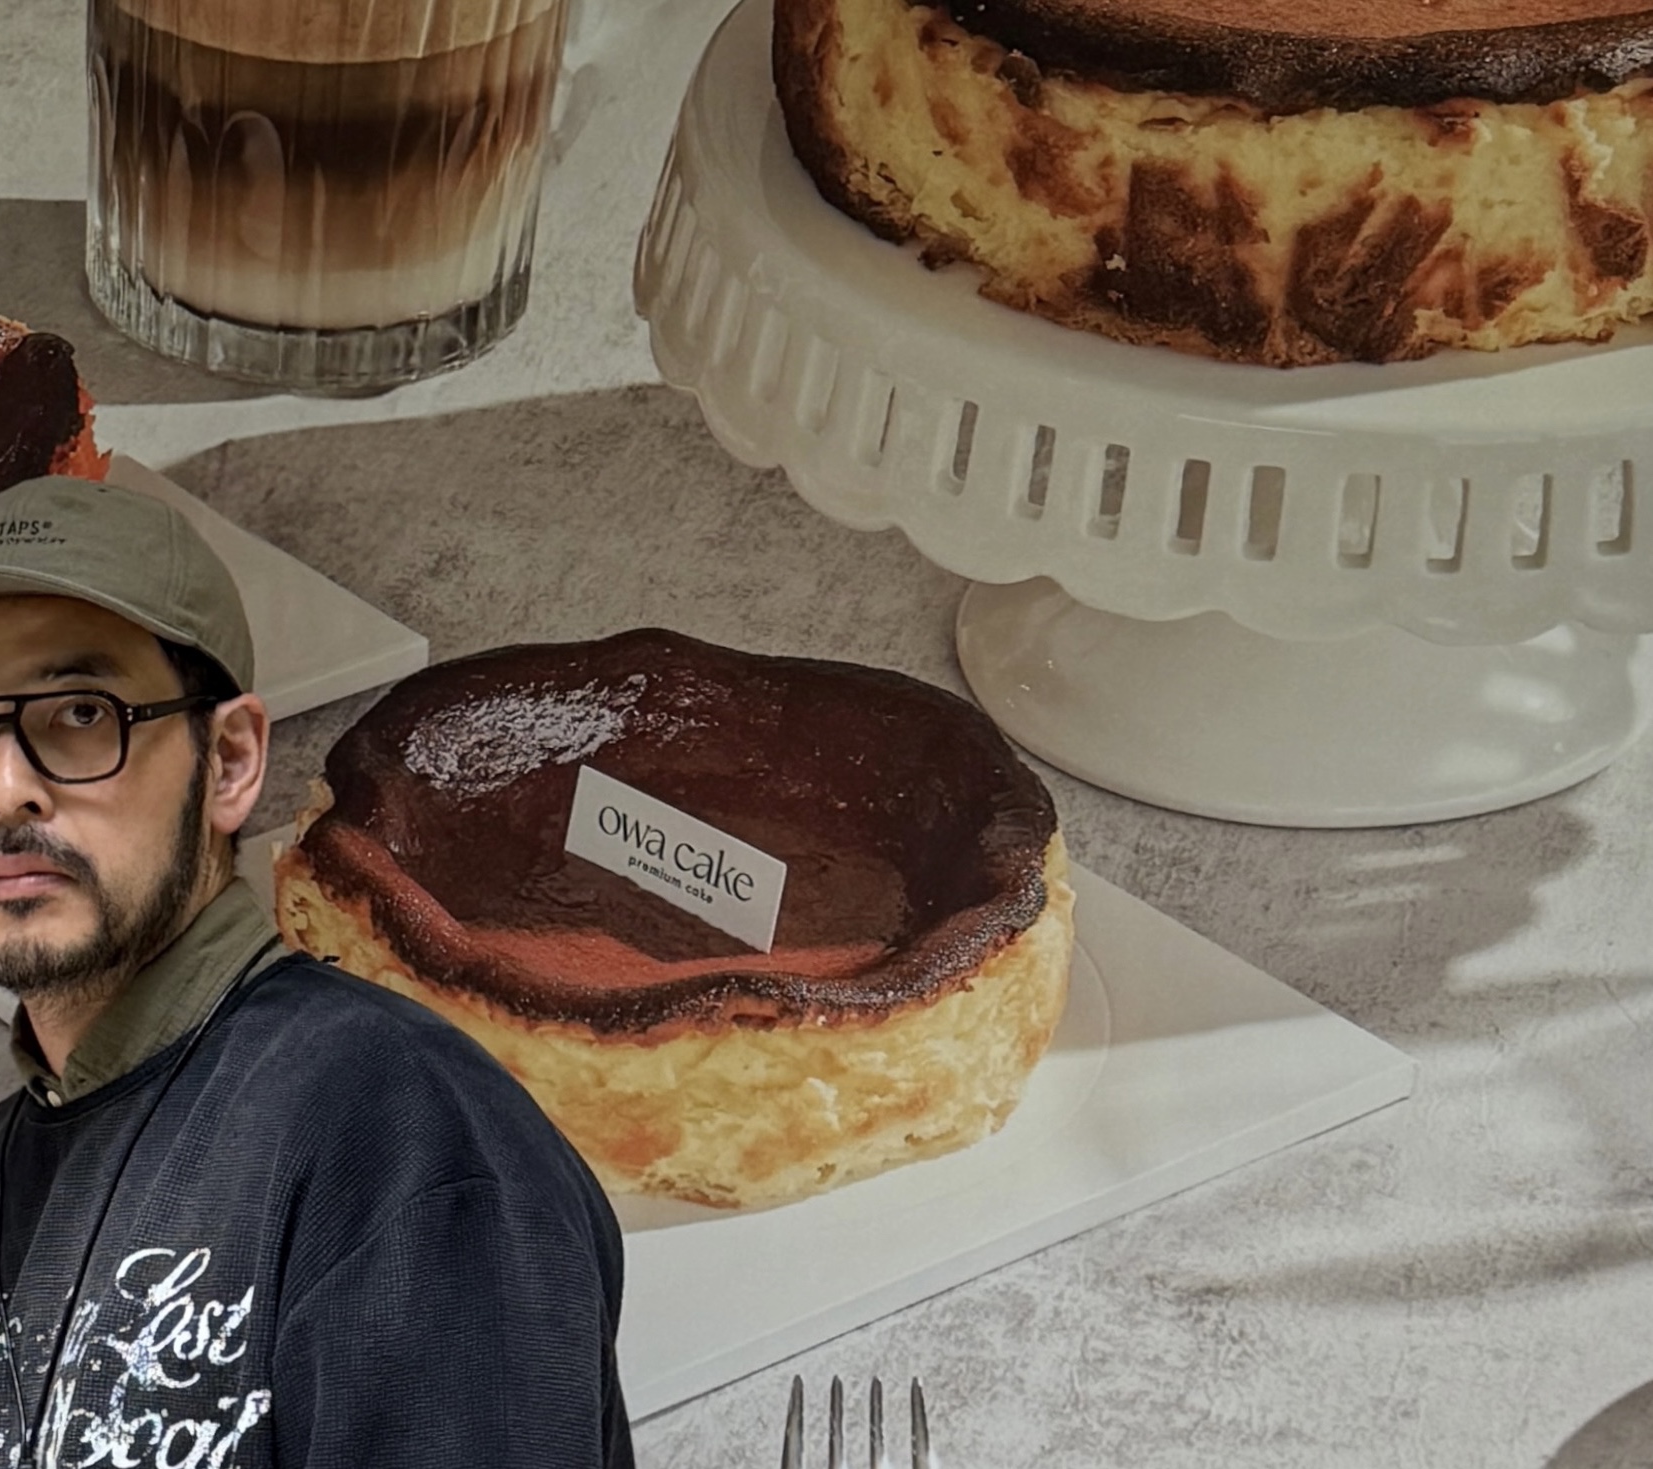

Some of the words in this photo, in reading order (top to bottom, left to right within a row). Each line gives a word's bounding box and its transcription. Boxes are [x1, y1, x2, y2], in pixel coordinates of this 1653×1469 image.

[598, 805, 667, 861] owa
[673, 842, 755, 902] cake
[628, 855, 682, 889] premium
[685, 884, 714, 904] cake
